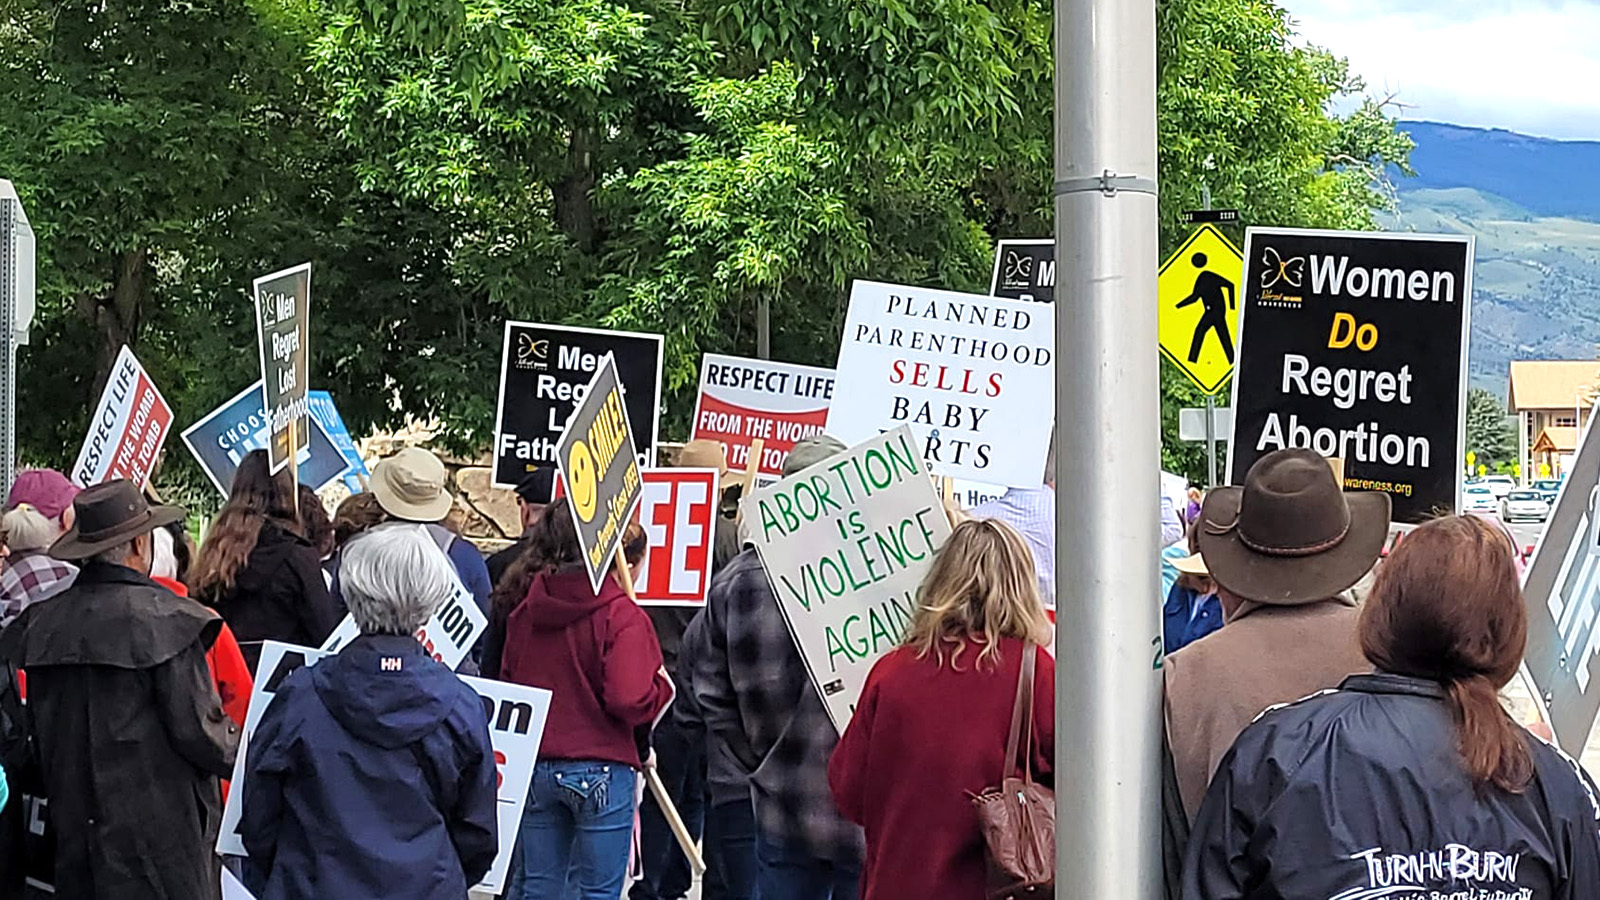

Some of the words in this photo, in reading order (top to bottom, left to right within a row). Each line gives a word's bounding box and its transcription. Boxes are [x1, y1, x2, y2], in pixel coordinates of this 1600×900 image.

[1310, 254, 1455, 303] Women
[276, 293, 296, 323] Men
[886, 295, 1031, 331] PLANNED
[272, 324, 300, 362] Regret
[855, 324, 1051, 367] PARENTHOOD
[1328, 312, 1379, 351] Do
[278, 362, 297, 395] Lost
[707, 364, 789, 393] RESPECT
[794, 375, 835, 400] LIFE
[889, 359, 1003, 397] SELLS
[1282, 354, 1412, 409] Regret
[79, 400, 117, 488] RESPECT
[112, 358, 136, 404] LIFE
[117, 437, 135, 470] THE
[129, 388, 155, 440] WOMB
[218, 408, 267, 449] CHOOS
[699, 411, 741, 435] FROM
[745, 417, 773, 438] THE
[890, 396, 989, 432] BABY
[138, 420, 161, 465] TOMB
[588, 386, 627, 482] SMILE!
[879, 430, 991, 468] RTS
[1256, 412, 1430, 468] Abortion
[732, 444, 752, 465] TH
[763, 448, 789, 470] TO
[758, 435, 919, 543] ABORTION
[837, 511, 866, 539] IS
[780, 507, 932, 612] VIOLENCE
[825, 591, 917, 672] AGAIN
[381, 658, 401, 671] HH
